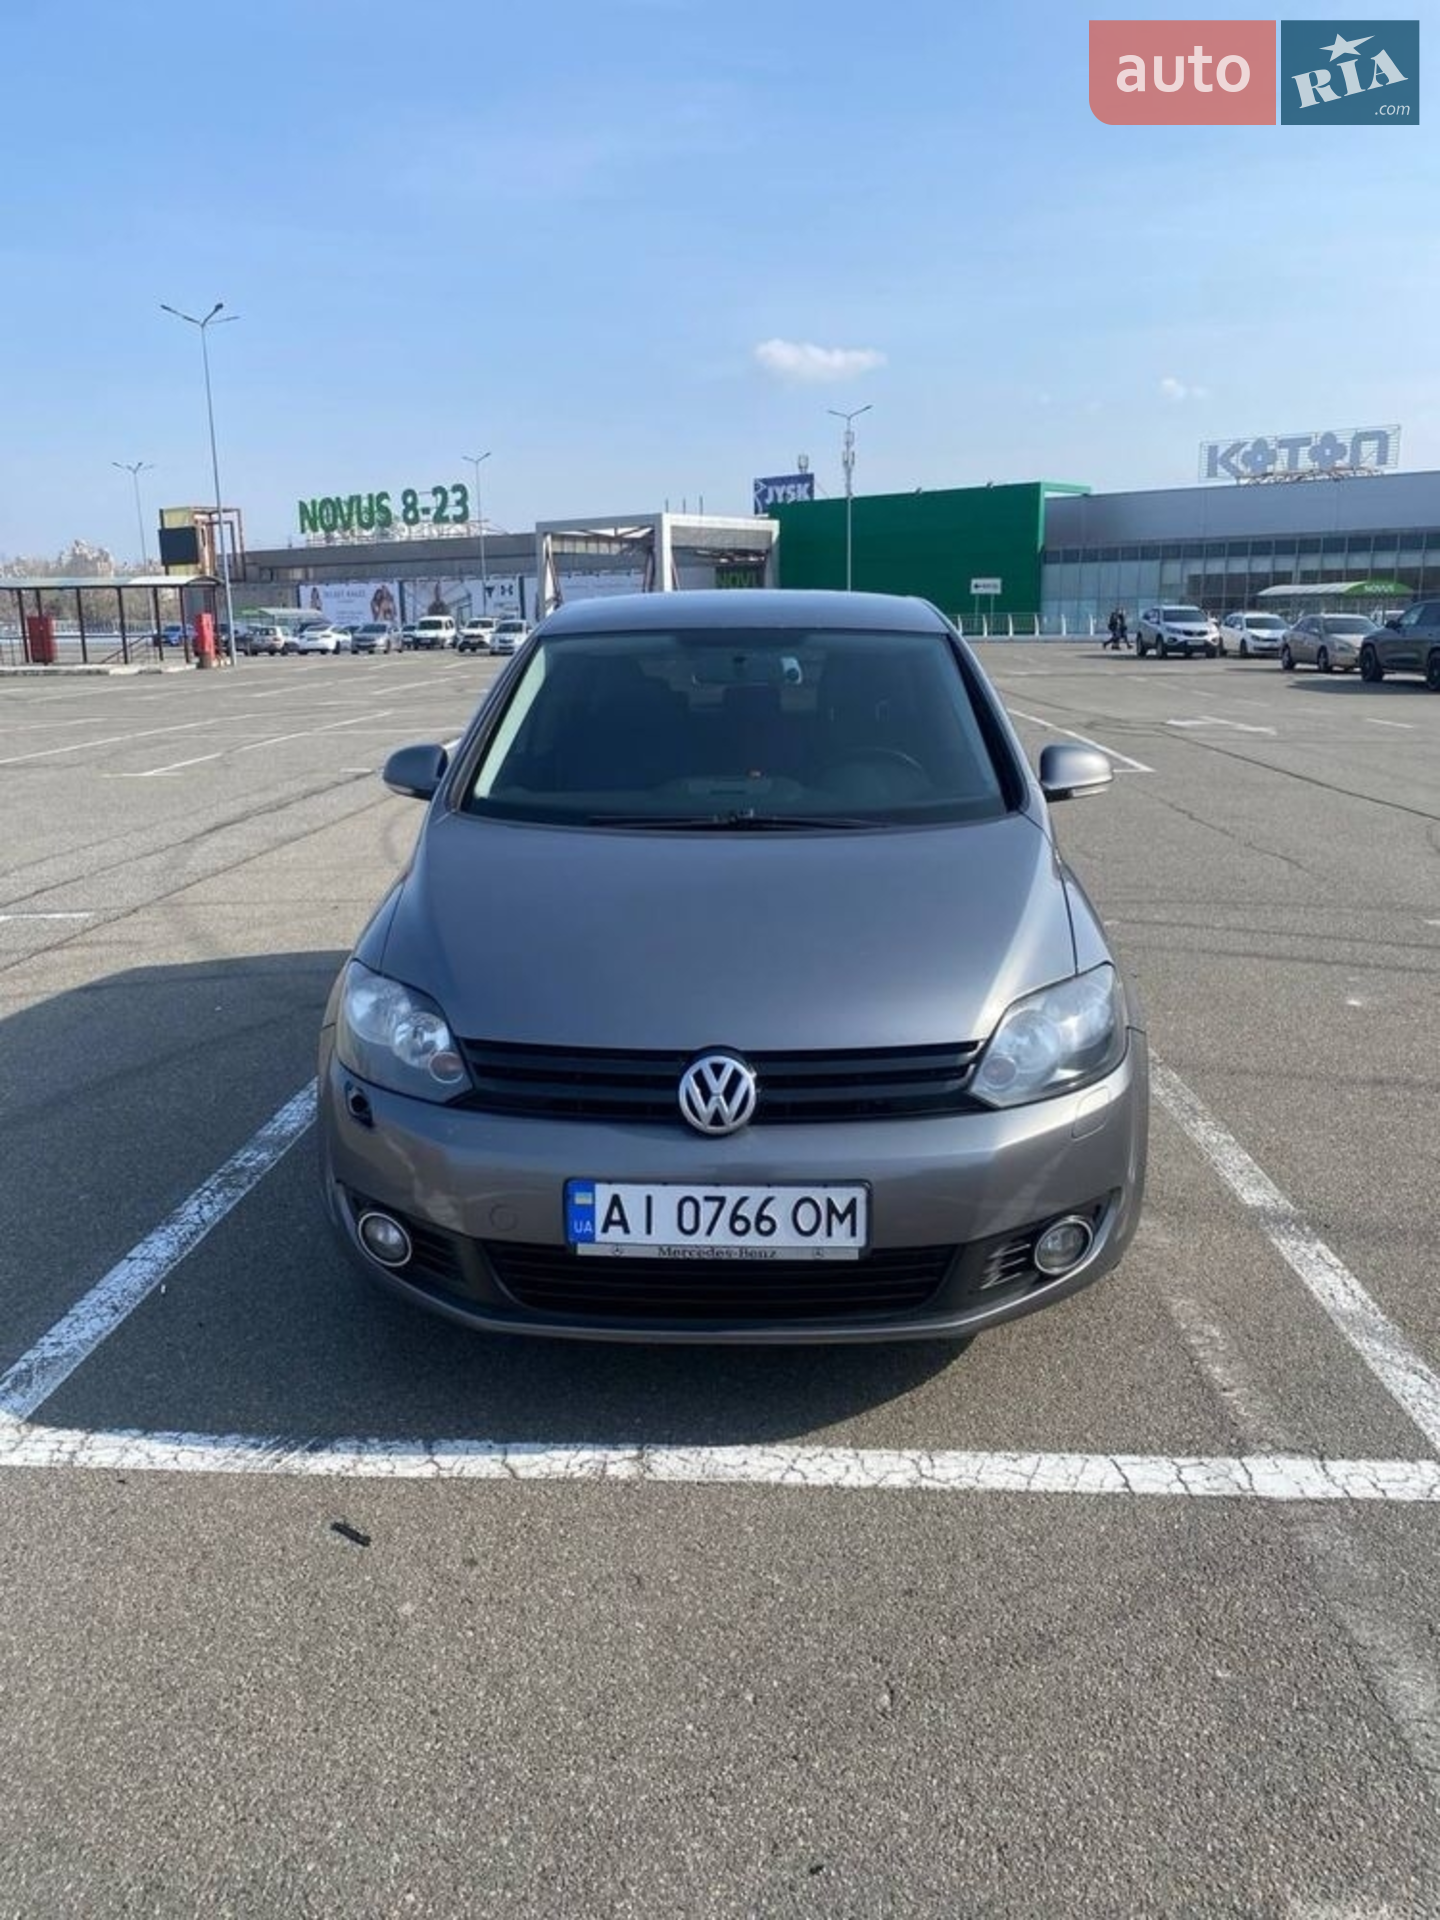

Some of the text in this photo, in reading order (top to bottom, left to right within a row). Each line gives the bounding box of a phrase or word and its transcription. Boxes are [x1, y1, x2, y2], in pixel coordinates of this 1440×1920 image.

[299, 483, 470, 534] NOVUS 8-23
[765, 483, 811, 504] JYSK
[681, 1058, 754, 1131] VW
[573, 1219, 594, 1234] UA
[600, 1193, 858, 1238] AI 0766 OM
[657, 1246, 777, 1259] Mercedes-Benz
